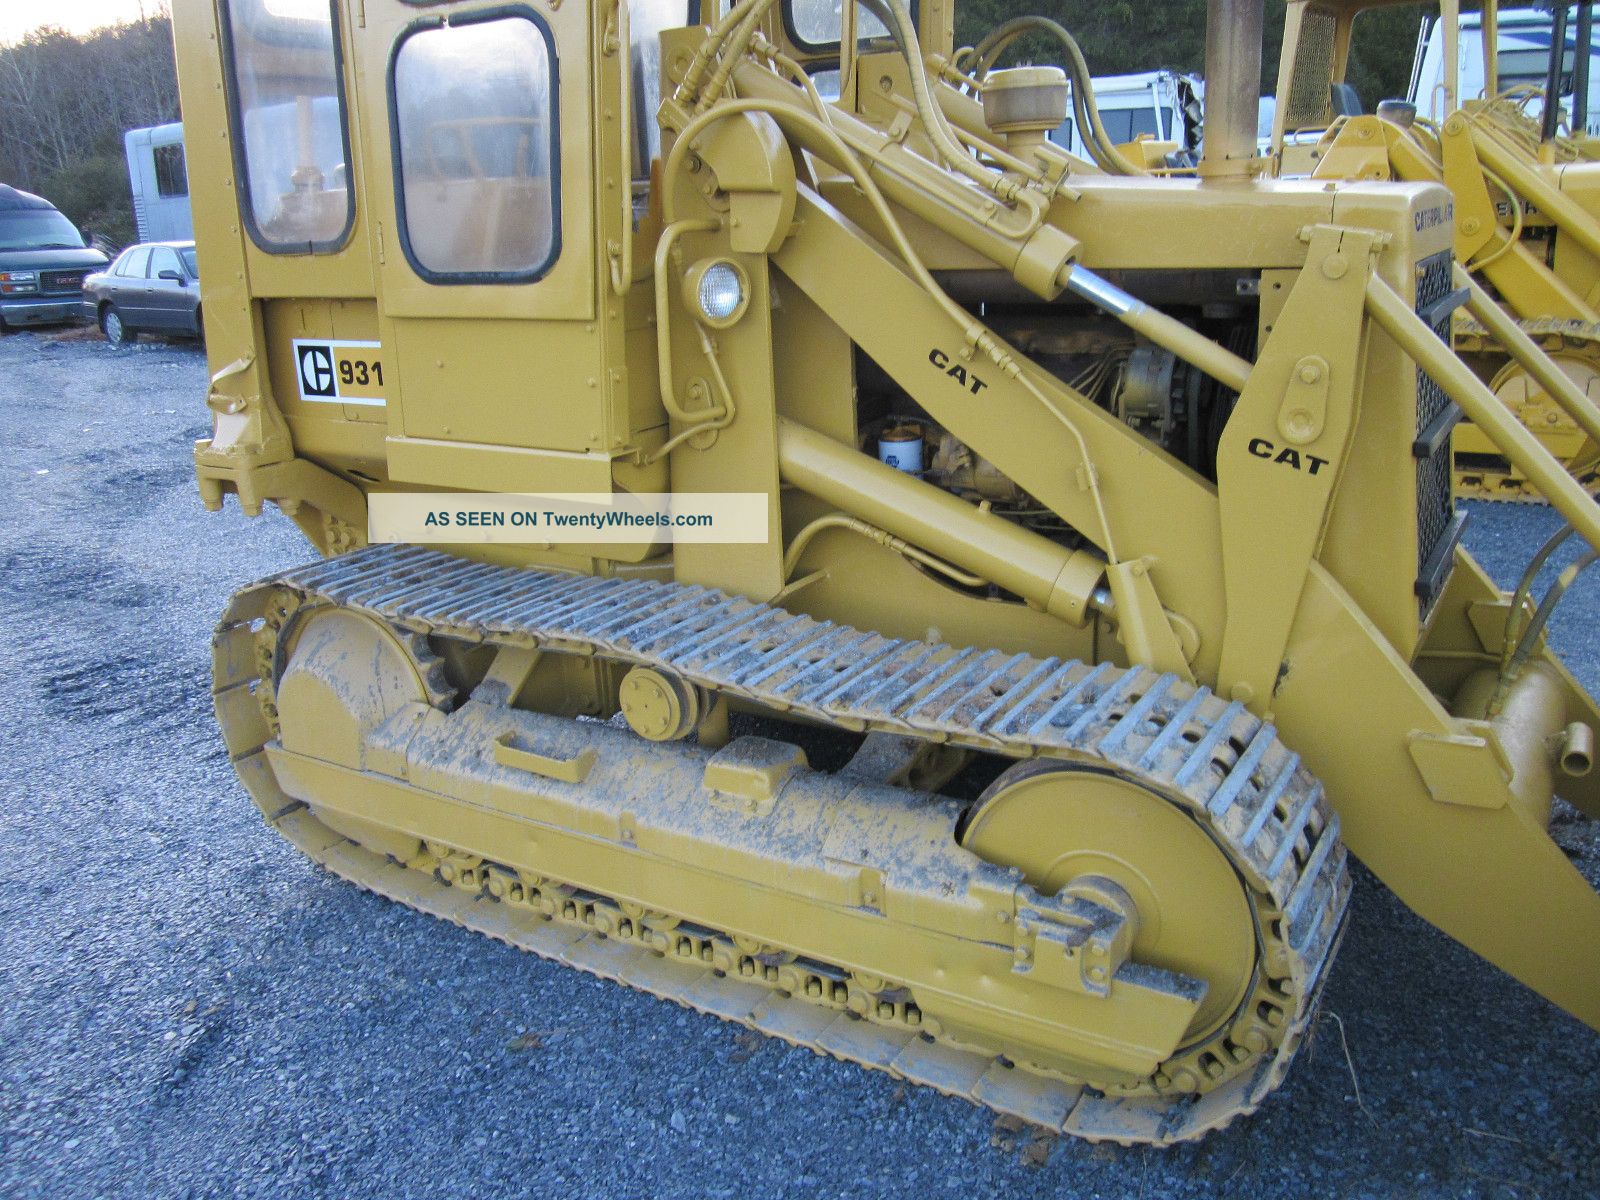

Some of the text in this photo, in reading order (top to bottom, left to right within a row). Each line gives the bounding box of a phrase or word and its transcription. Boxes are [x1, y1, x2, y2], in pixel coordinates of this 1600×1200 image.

[339, 359, 384, 386] 931
[928, 348, 988, 395] CAT
[1248, 438, 1329, 475] CAT
